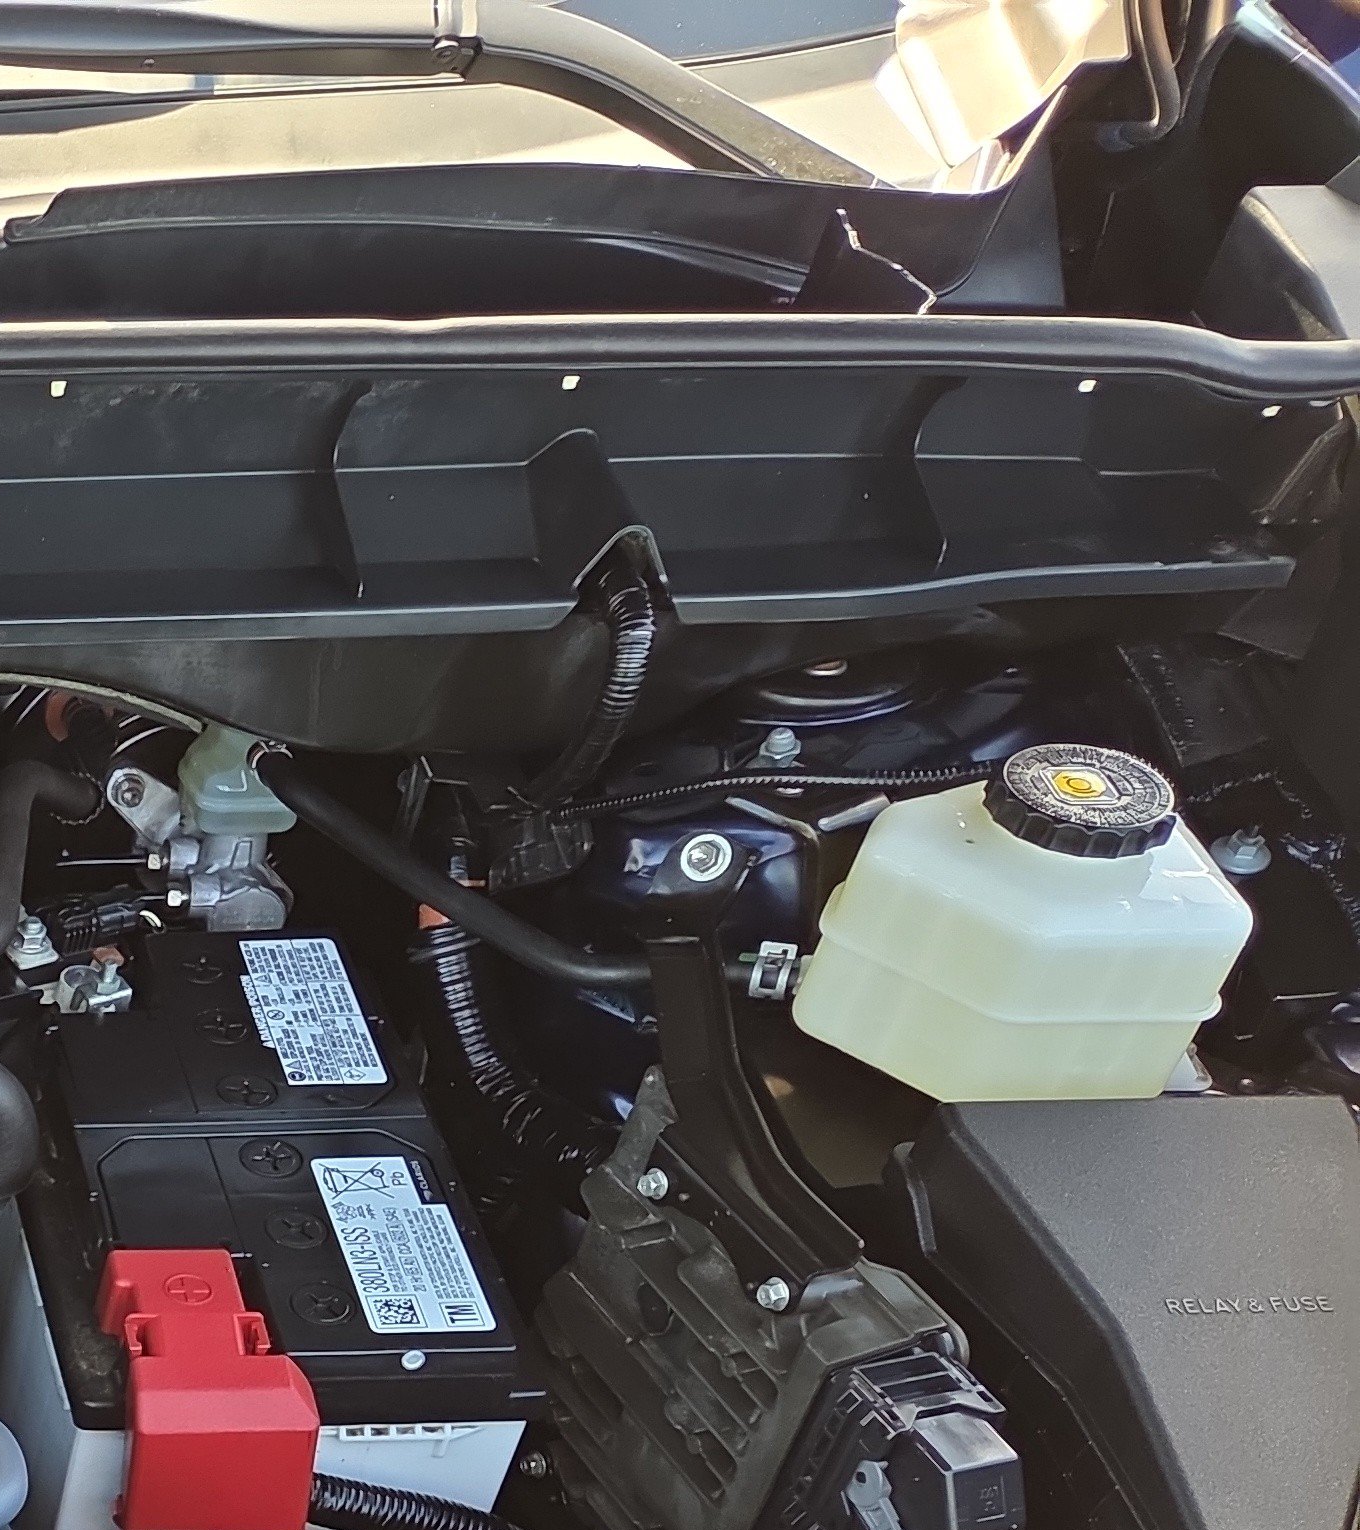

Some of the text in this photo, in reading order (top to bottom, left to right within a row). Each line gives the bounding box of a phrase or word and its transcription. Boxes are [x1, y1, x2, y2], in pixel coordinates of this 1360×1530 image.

[391, 1171, 408, 1186] Pb
[340, 1226, 390, 1293] 380LN3-ISS
[444, 1304, 479, 1324] TM
[1165, 1295, 1334, 1314] RELAY & FUSE
